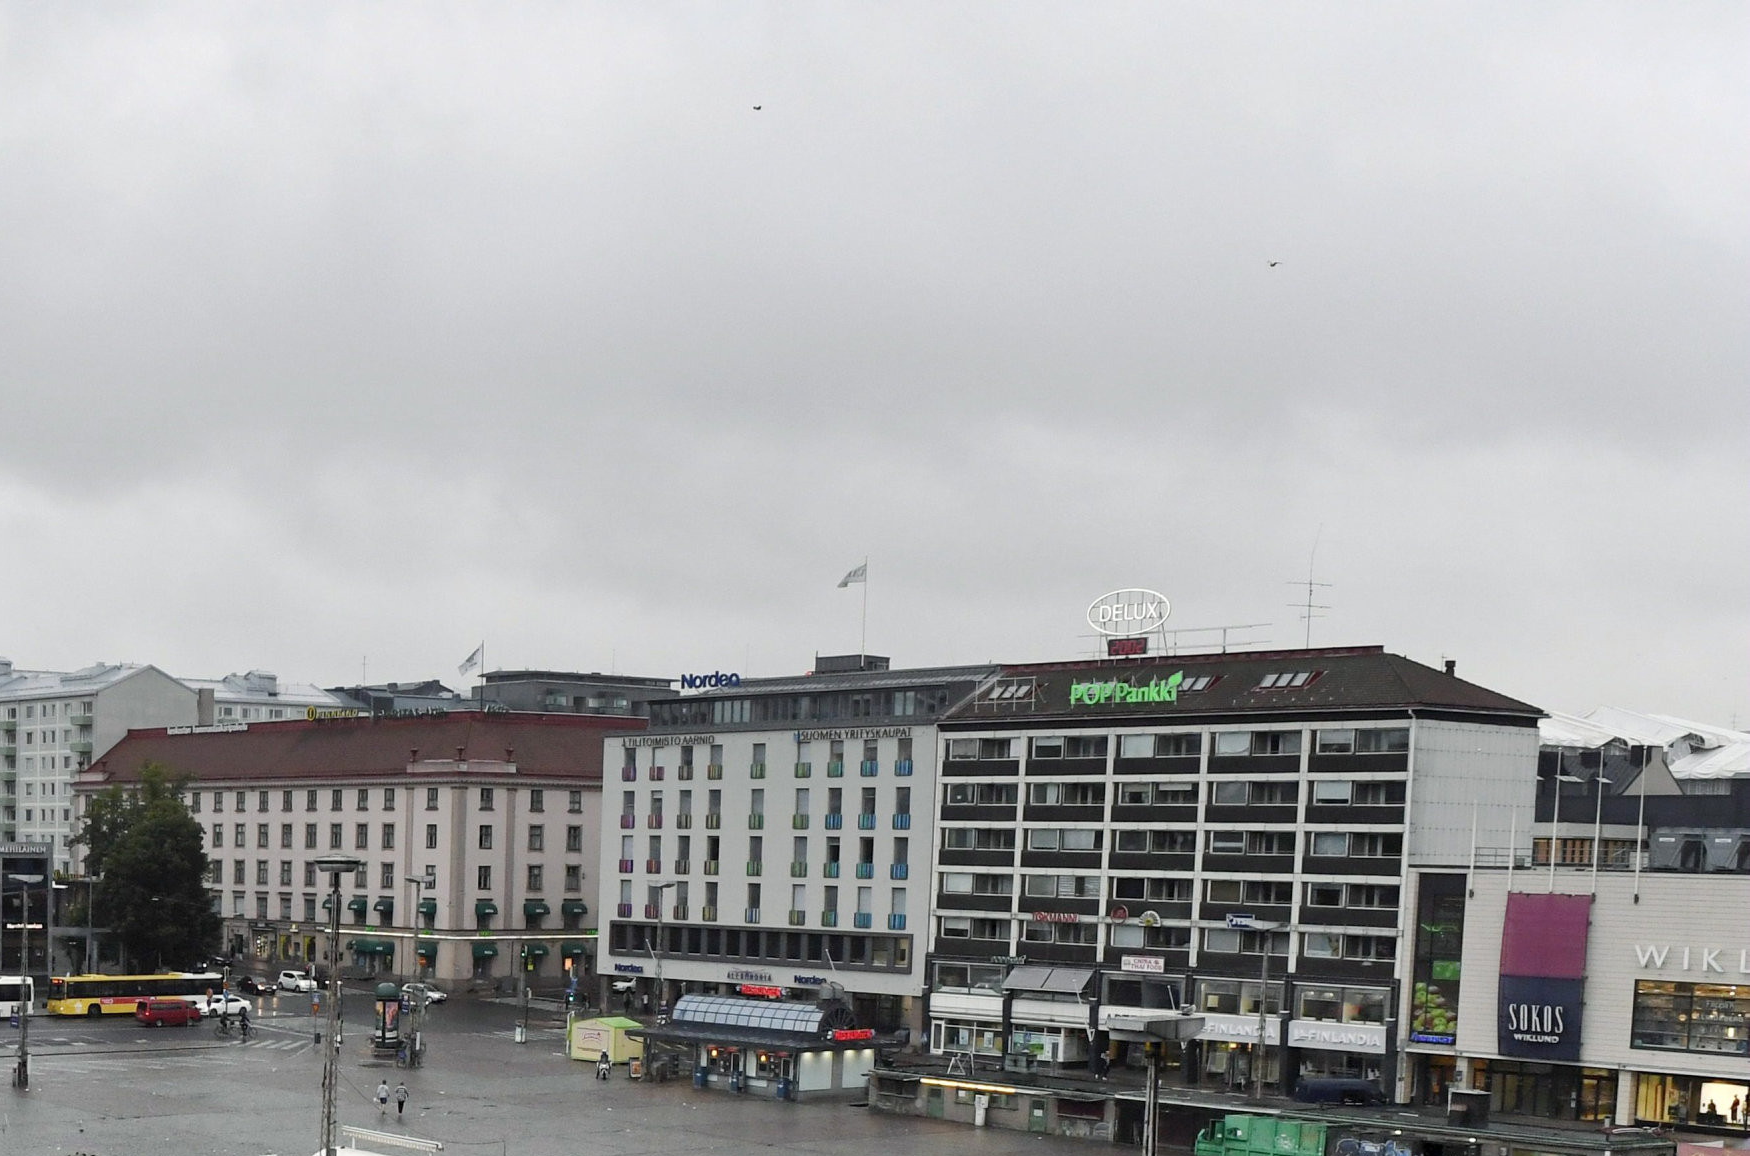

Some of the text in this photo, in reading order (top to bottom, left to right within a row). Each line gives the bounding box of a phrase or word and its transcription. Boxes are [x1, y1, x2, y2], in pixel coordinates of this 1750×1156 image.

[1099, 602, 1158, 622] DELUX
[681, 670, 740, 690] Nordea
[1070, 679, 1178, 705] POP Pankki
[628, 735, 715, 747] TILITOIMISTO AARNIO
[801, 727, 912, 741] SUOMEN YRITYSKAUPAT
[614, 963, 644, 974] Nordea
[1508, 1003, 1564, 1034] SOKOS
[1309, 1029, 1381, 1048] FINLANDIA
[1513, 1032, 1560, 1044] WIKLUND
